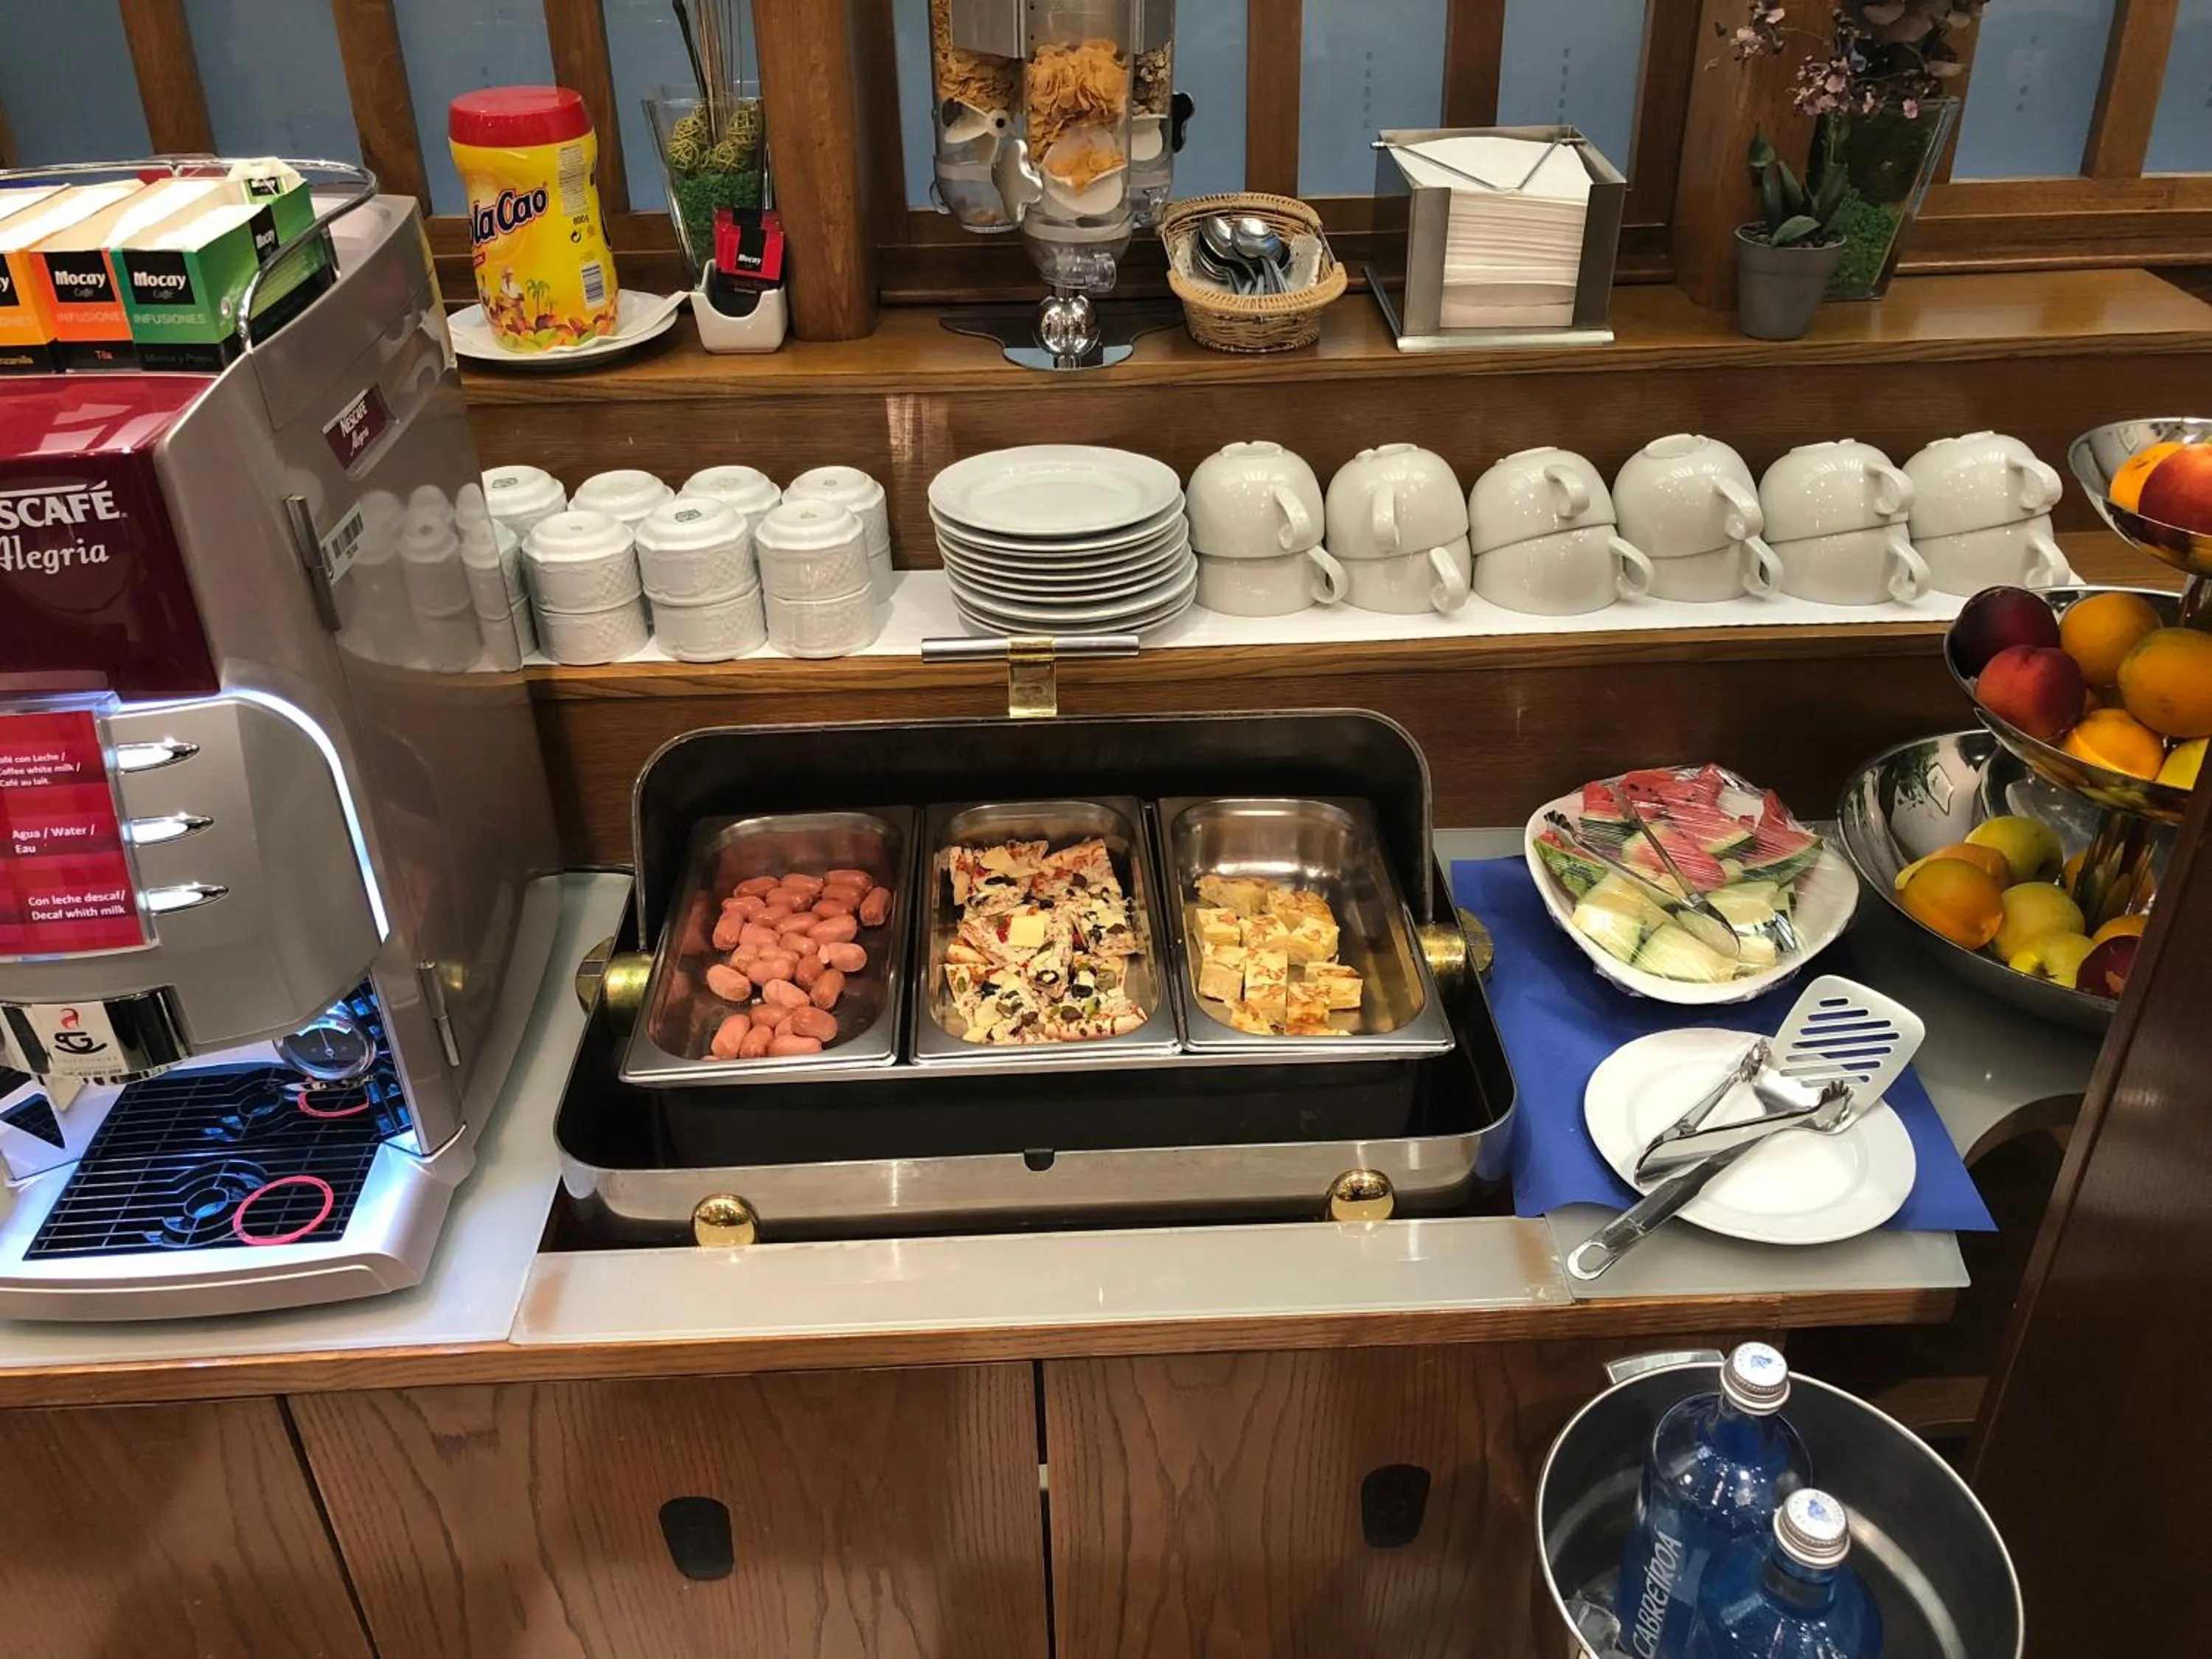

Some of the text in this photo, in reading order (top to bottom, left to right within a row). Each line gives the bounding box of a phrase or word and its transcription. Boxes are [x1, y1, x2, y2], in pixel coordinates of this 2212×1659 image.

[55, 271, 106, 288] Mocay
[133, 271, 186, 290] Mocay
[133, 313, 207, 324] INFUSIONES
[0, 535, 110, 575] Alegria
[32, 753, 59, 762] Leche
[55, 763, 74, 772] milk
[13, 824, 95, 841] Agua / Water /
[15, 844, 36, 854] Eau
[28, 897, 49, 906] Con
[52, 894, 82, 905] leche
[32, 905, 126, 921] Decaf whith milk
